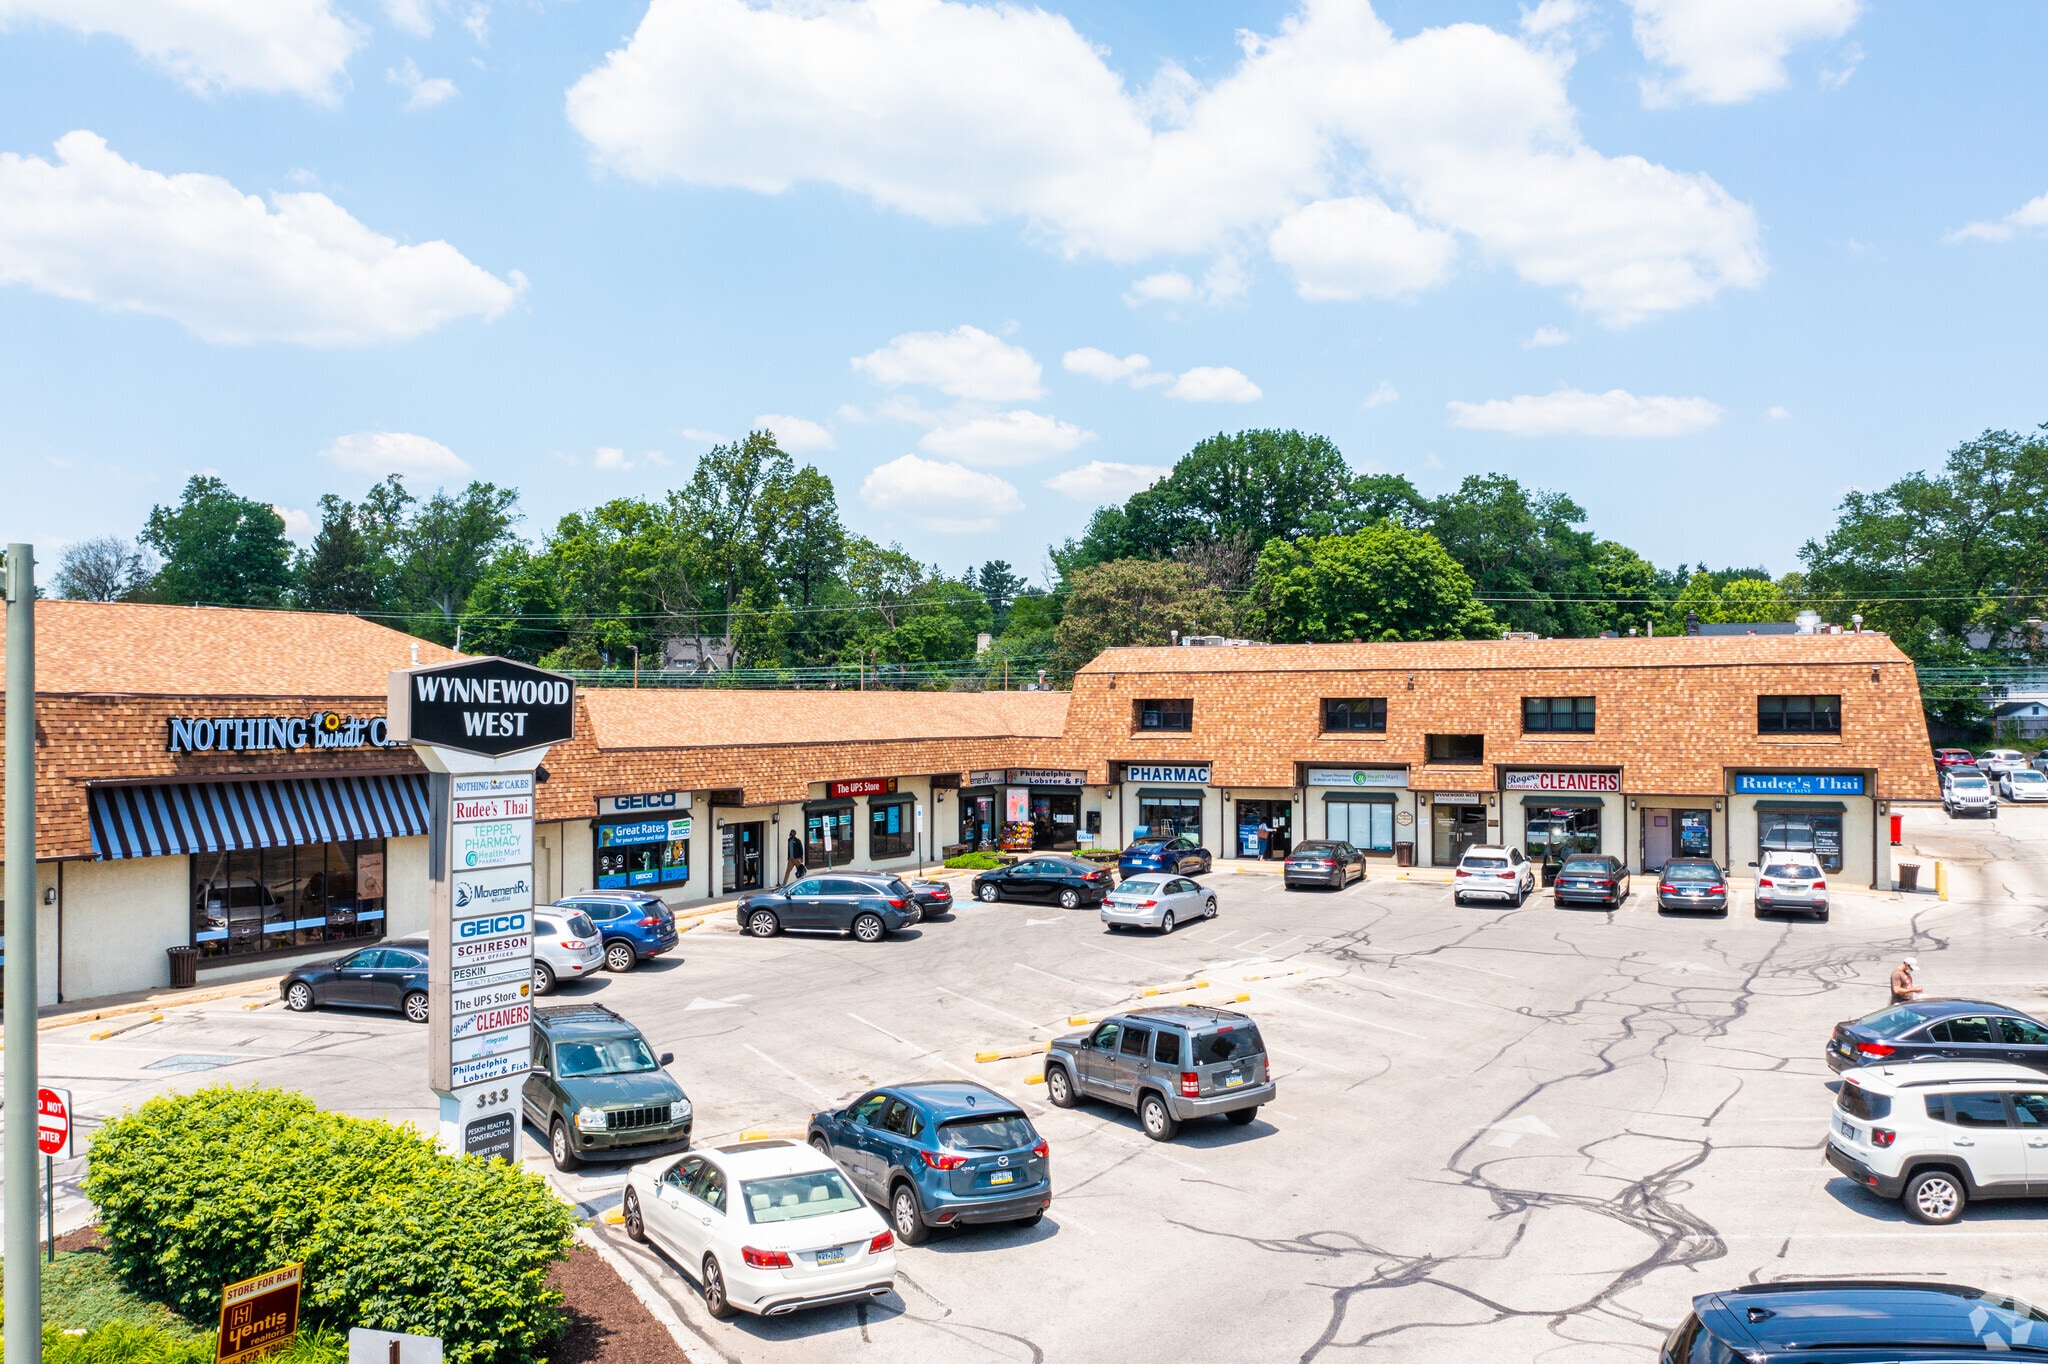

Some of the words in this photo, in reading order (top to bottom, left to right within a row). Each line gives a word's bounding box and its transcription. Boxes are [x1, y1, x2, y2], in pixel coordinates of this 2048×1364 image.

[416, 676, 569, 705] WYNNEWOOD
[170, 718, 307, 751] NOTHING
[310, 712, 369, 749] bundt
[463, 711, 528, 737] WEST
[1130, 767, 1209, 782] PHARMAC
[1507, 774, 1540, 784] Rogers
[1540, 773, 1617, 790] CLEANERS
[1742, 777, 1811, 789] Rudee's
[1816, 777, 1858, 789] Thai
[456, 781, 489, 792] NOTHING
[504, 780, 529, 790] CAKES
[837, 784, 849, 793] The
[850, 783, 863, 792] UPS
[864, 782, 880, 791] Store
[456, 801, 498, 818] Rudee's
[503, 799, 528, 815] Thai
[614, 793, 676, 810] GEICO
[473, 823, 513, 837] TEPPER
[616, 826, 640, 836] Great
[641, 824, 666, 834] Rates
[465, 835, 521, 850] PHARMACY
[478, 850, 503, 859] Health
[503, 848, 521, 857] Mart
[474, 880, 529, 899] MovementRx
[460, 914, 525, 938] GEICO
[458, 937, 528, 956] SCHIRESON
[488, 951, 514, 960] OFFICES
[453, 966, 486, 979] PESKIN
[466, 977, 487, 986] REALTY
[492, 971, 530, 983] CONSTRUCTION
[455, 1000, 471, 1011] The
[474, 994, 492, 1007] UPS
[494, 992, 517, 1003] Store
[477, 1005, 529, 1032] CLEANERS
[453, 1057, 508, 1075] Philadelphia
[463, 1070, 498, 1083] Lobster
[501, 1066, 508, 1074] &
[511, 1061, 528, 1072] Fish
[38, 1099, 43, 1110] O
[47, 1101, 62, 1114] NOT
[476, 1088, 509, 1109] 333
[468, 1125, 486, 1136] PESKIN
[487, 1120, 505, 1130] REALTY
[468, 1127, 511, 1144] CONSTRUCTION
[38, 1130, 60, 1144] NTER
[491, 1142, 510, 1152] YENTIS
[227, 1283, 255, 1300] STORE
[257, 1276, 274, 1290] FOR
[276, 1268, 298, 1283] RENT
[250, 1328, 286, 1346] realtors
